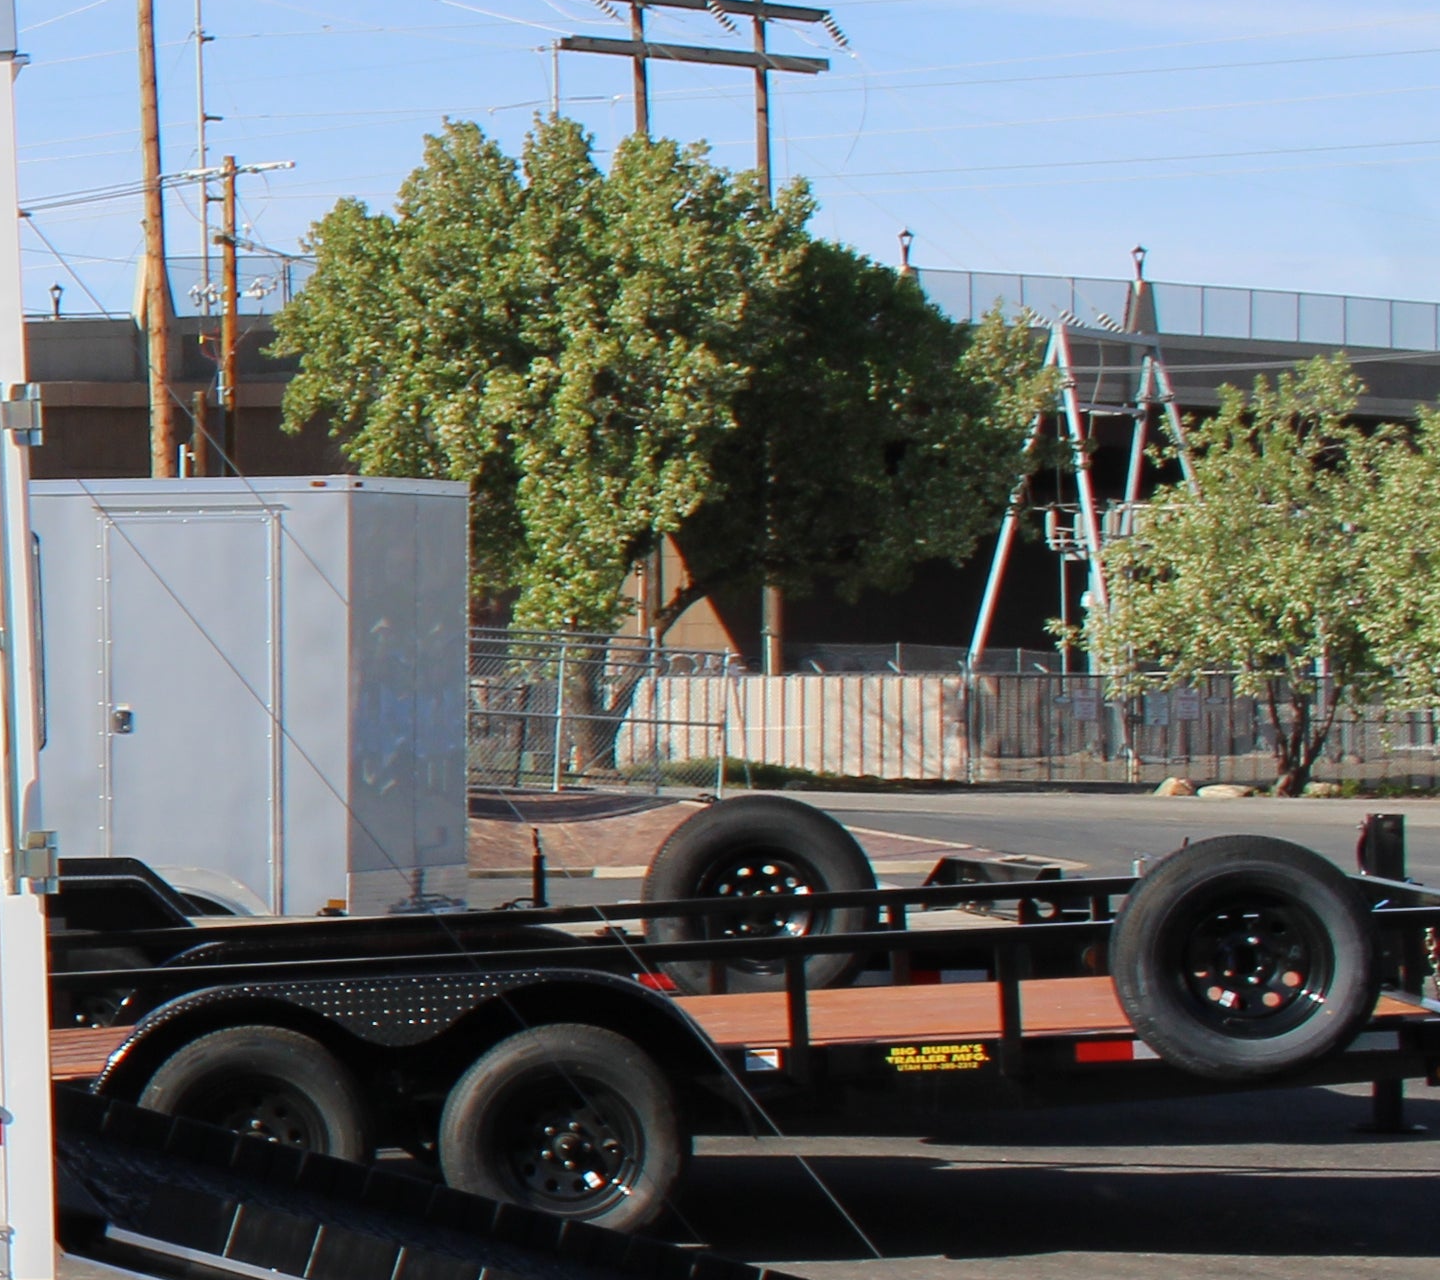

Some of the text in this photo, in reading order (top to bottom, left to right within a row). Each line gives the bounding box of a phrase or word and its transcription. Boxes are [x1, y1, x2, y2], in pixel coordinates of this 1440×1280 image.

[890, 1044, 983, 1056] BIG BUBBA'S
[885, 1054, 947, 1064] TRAILER
